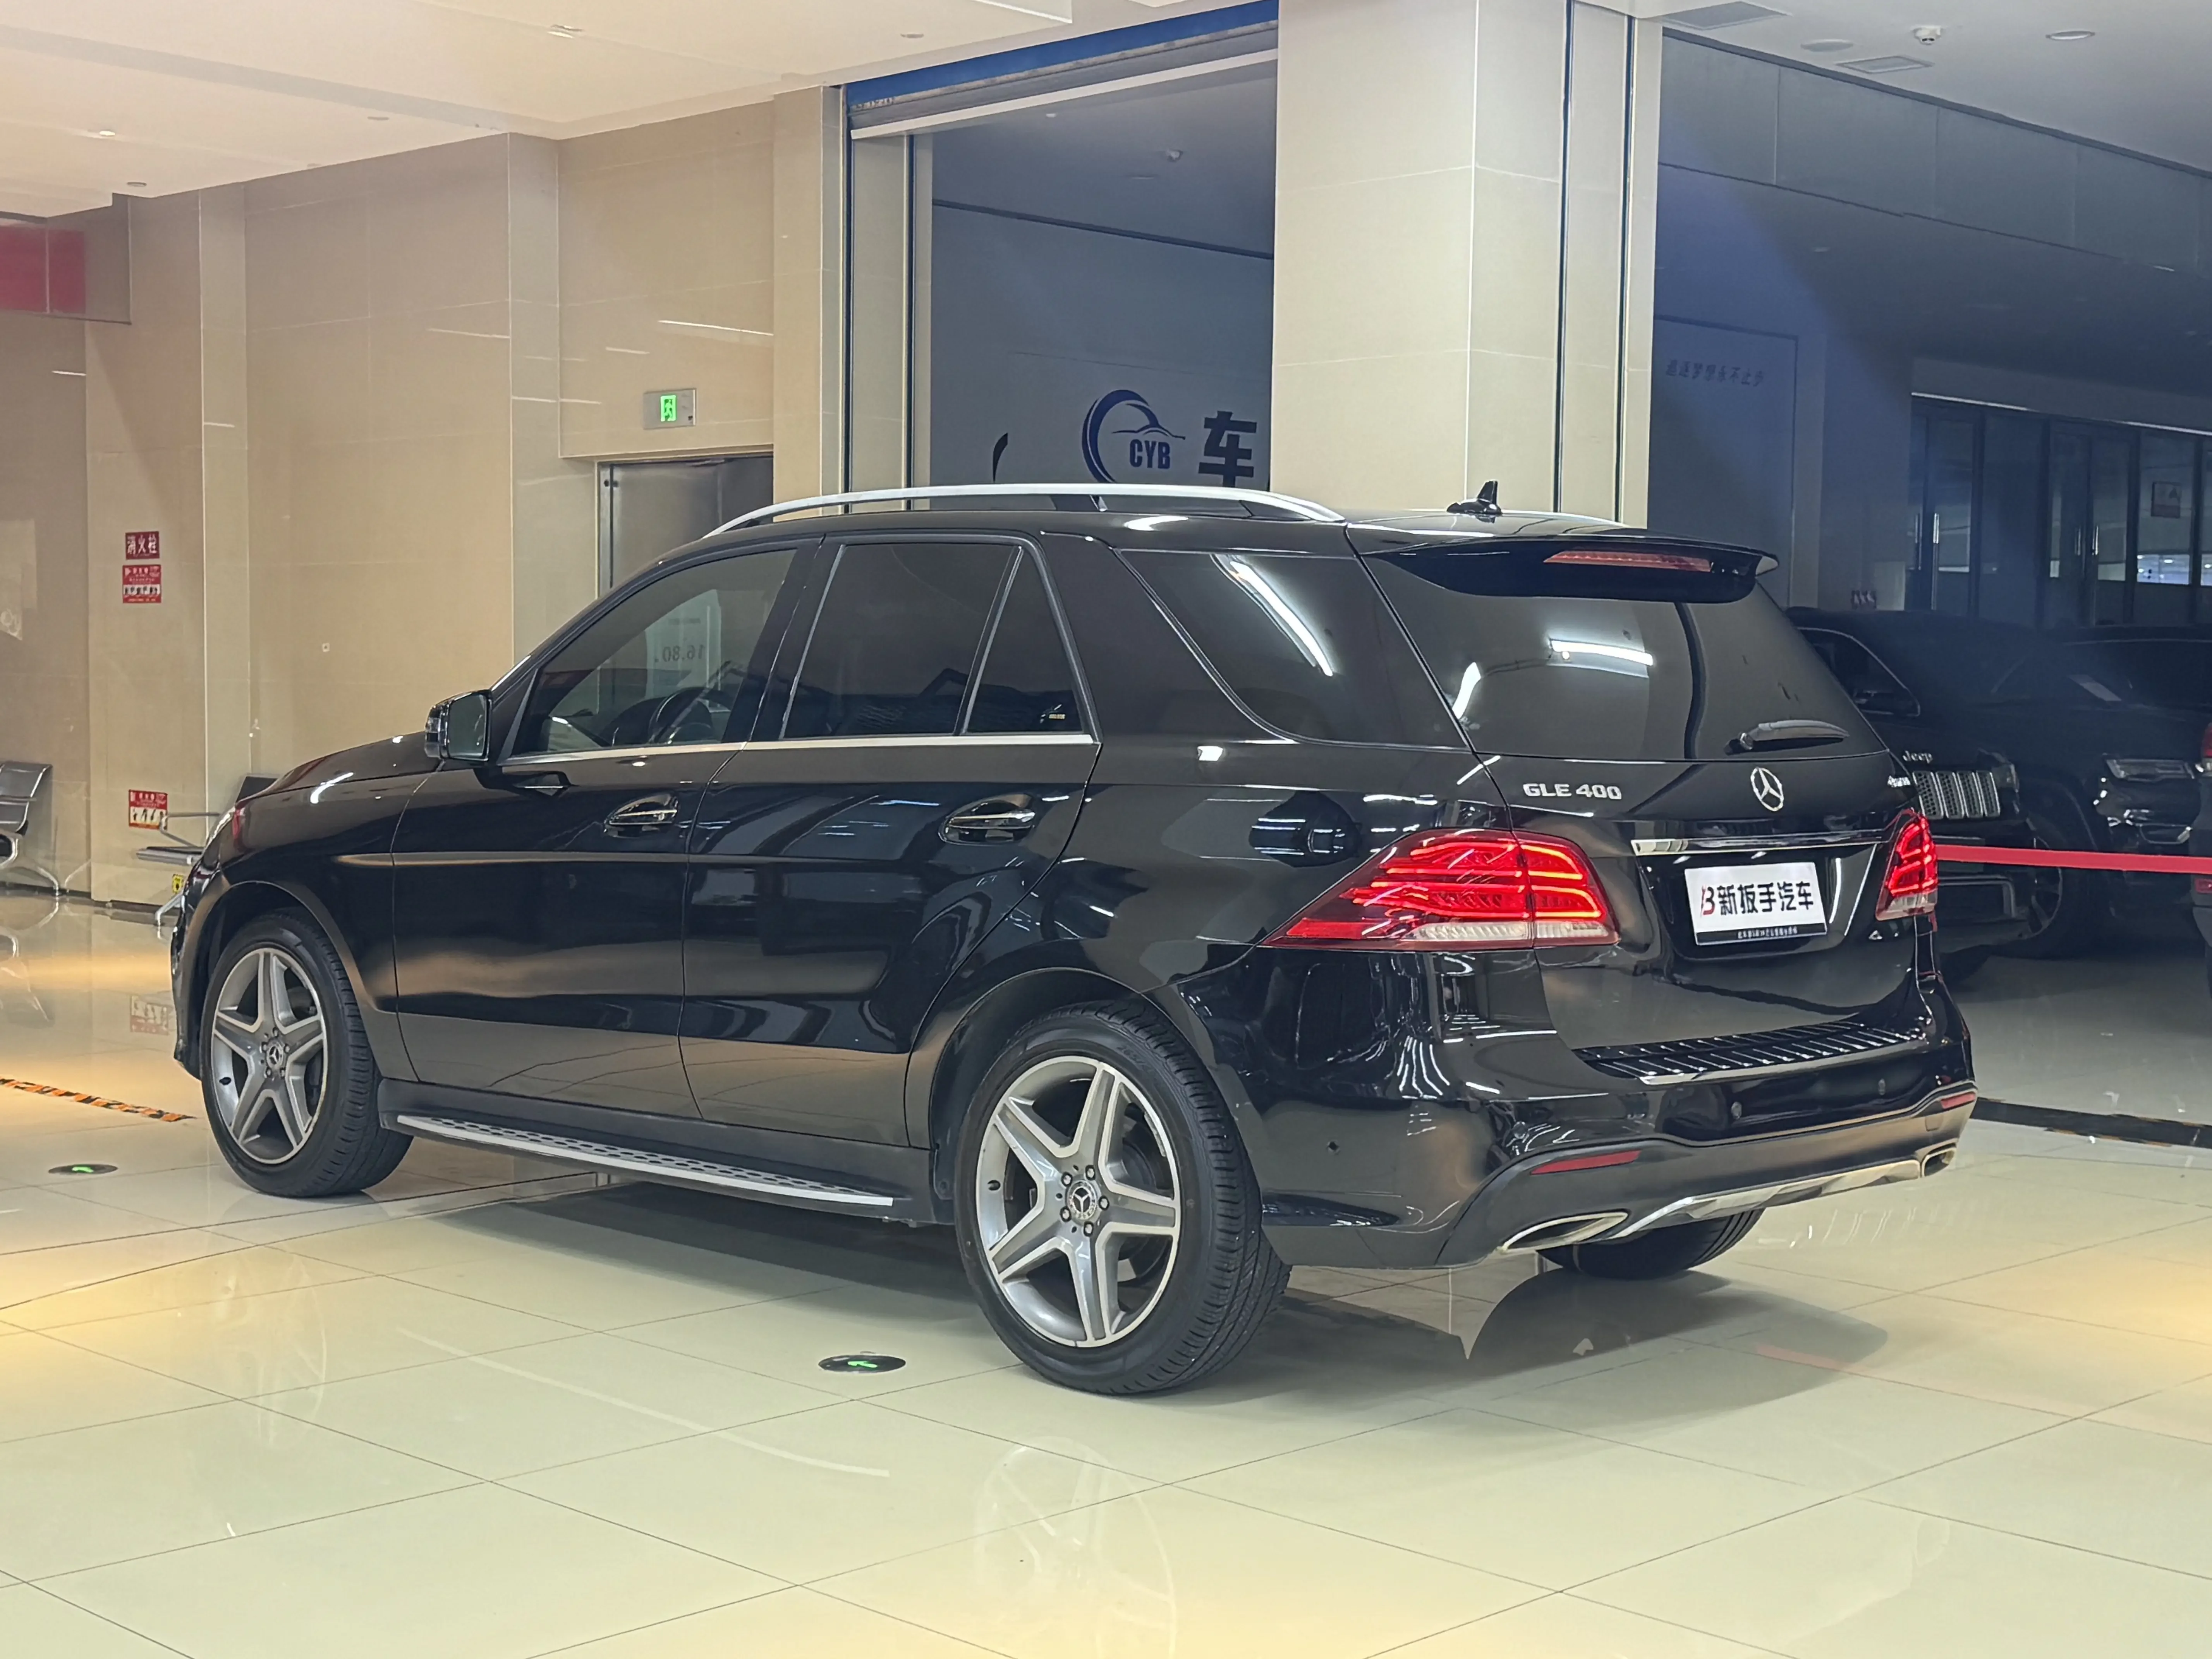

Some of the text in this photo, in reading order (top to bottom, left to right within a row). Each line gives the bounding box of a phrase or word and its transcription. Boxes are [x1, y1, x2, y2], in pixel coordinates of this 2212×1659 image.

[1129, 439, 1171, 470] CYB
[1198, 410, 1257, 488] 车
[127, 533, 157, 555] 消火栓
[1903, 750, 1933, 764] Jeep
[1523, 783, 1622, 800] GLE 400
